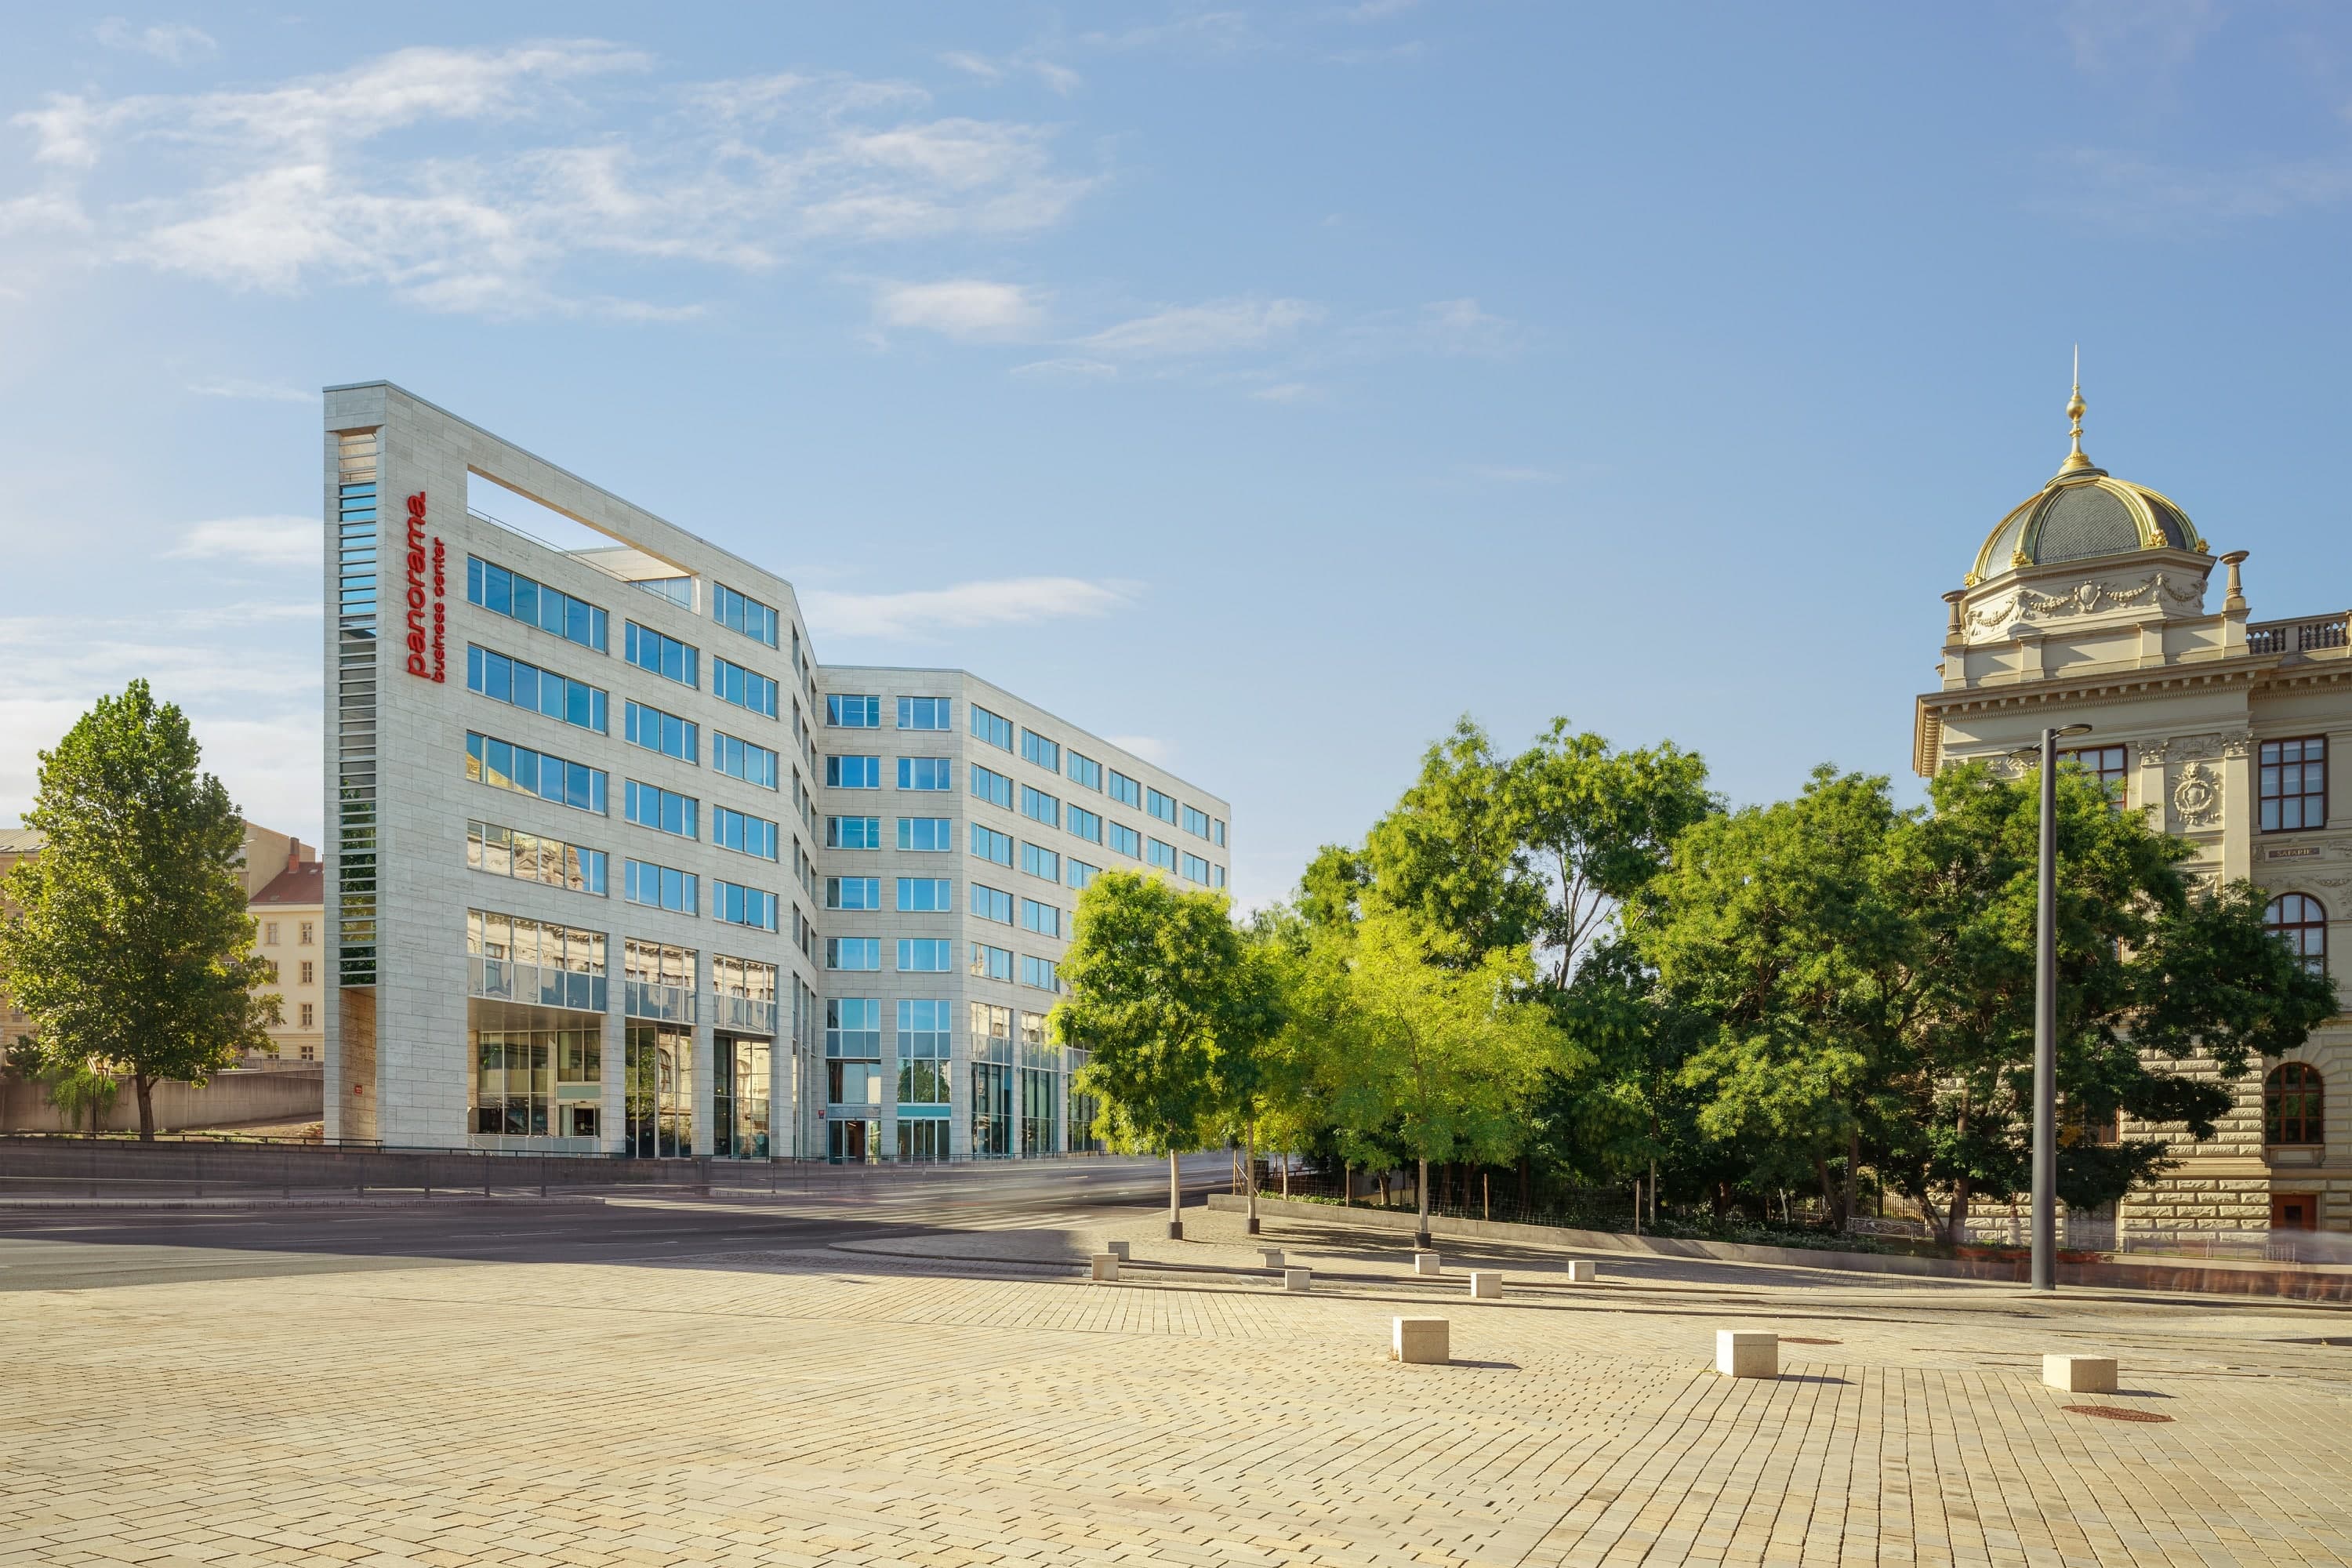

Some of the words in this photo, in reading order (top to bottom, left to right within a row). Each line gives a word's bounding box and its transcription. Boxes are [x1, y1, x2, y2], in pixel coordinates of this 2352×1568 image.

[407, 491, 430, 679] panorama
[432, 537, 446, 597] center
[431, 601, 446, 684] business
